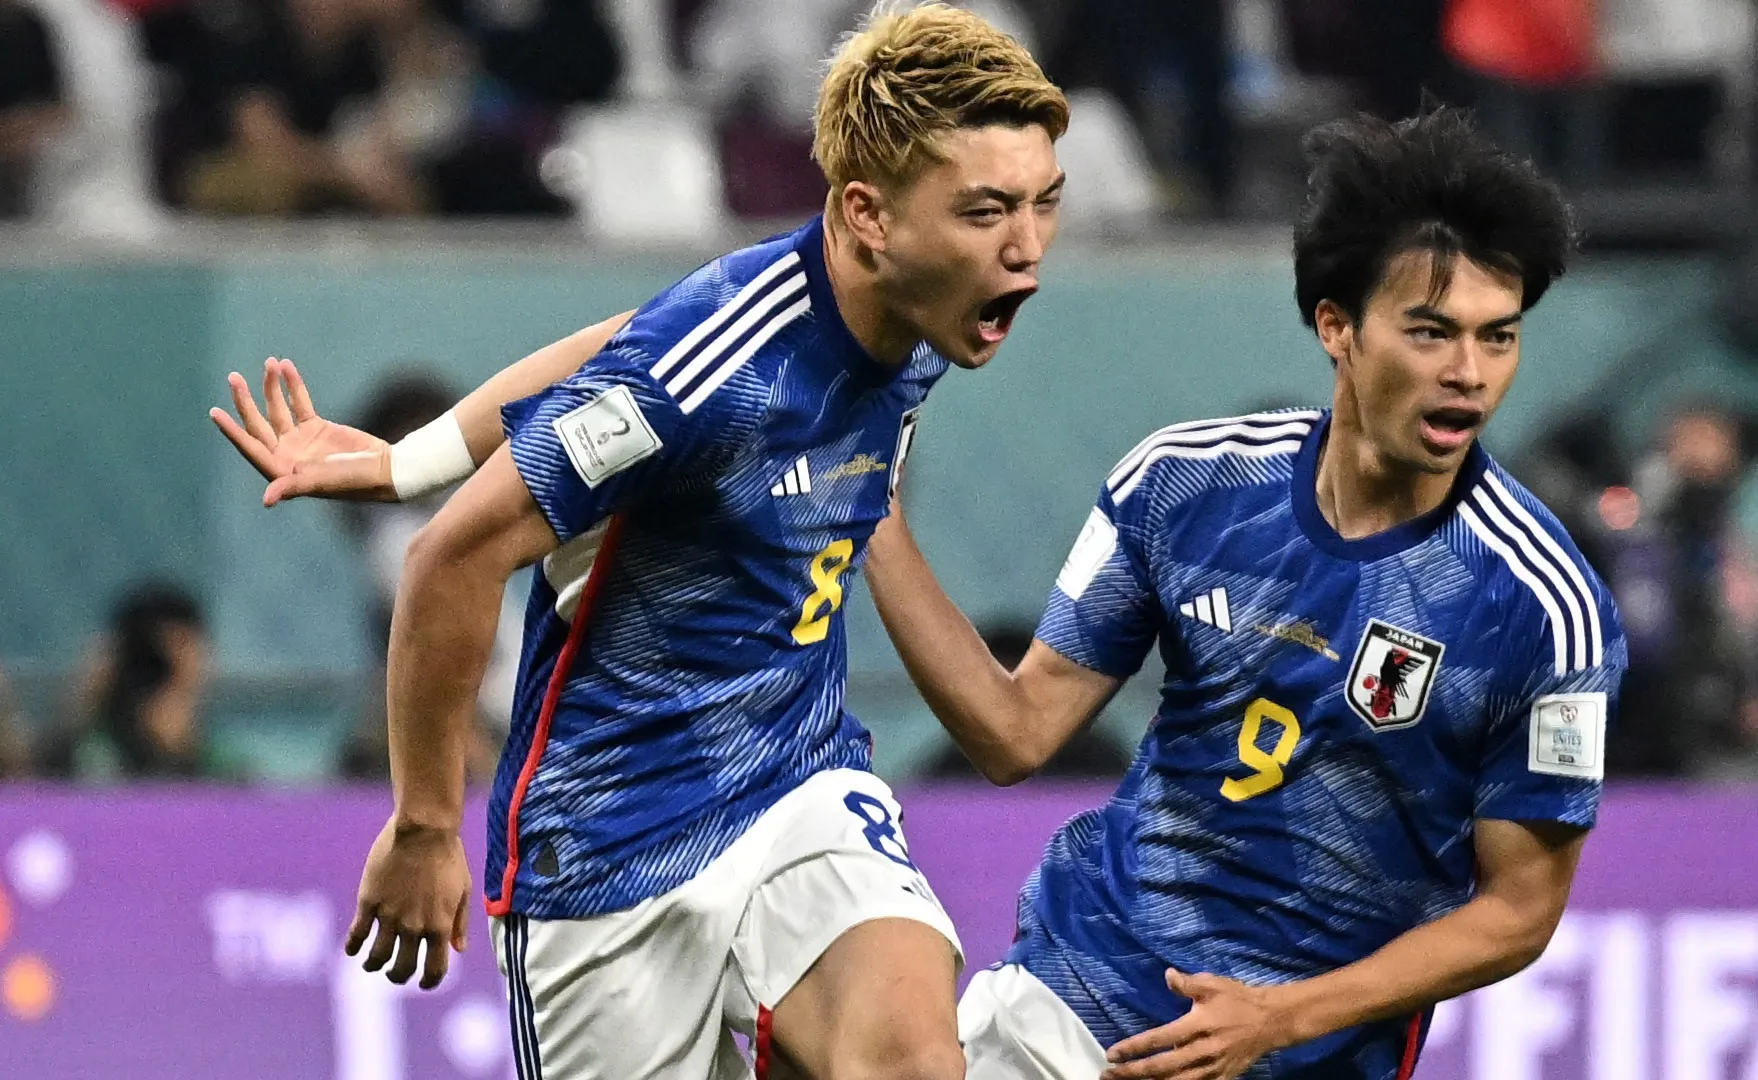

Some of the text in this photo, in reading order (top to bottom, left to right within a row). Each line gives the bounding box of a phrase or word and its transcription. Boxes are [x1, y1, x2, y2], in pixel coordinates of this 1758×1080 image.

[791, 538, 853, 646] 8
[1385, 629, 1424, 650] JAPAN
[1219, 697, 1301, 803] 9
[843, 790, 919, 875] 8
[1472, 910, 1758, 1080] FIF
